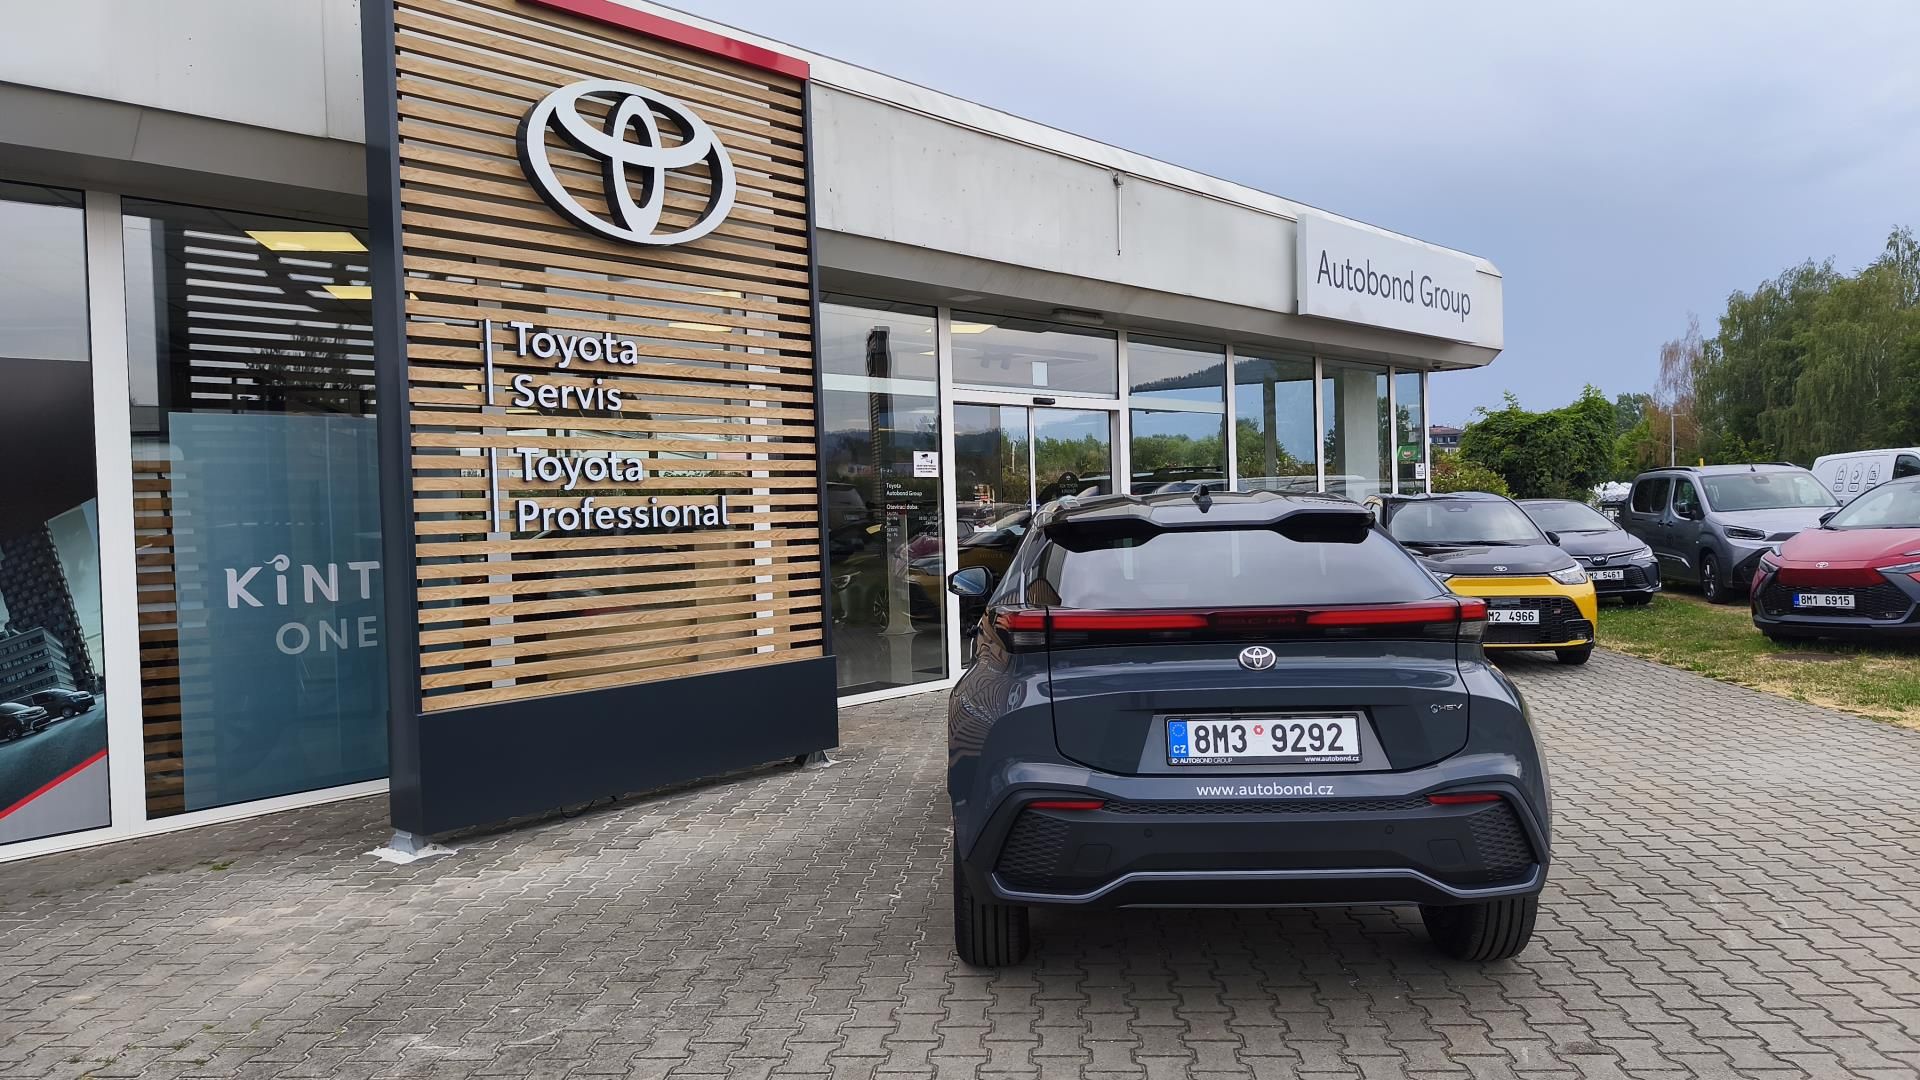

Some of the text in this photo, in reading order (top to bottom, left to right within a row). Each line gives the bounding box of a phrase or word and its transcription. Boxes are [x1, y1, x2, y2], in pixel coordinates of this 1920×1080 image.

[1317, 250, 1471, 322] Autobond Group
[511, 321, 638, 369] Toyota
[514, 374, 623, 411] Servis
[516, 447, 644, 490] Toyota
[517, 496, 730, 532] Professional
[1602, 571, 1621, 579] 5461
[1508, 611, 1535, 622] 4966
[1800, 595, 1818, 605] 8M1
[1825, 595, 1850, 606] 6915
[275, 616, 379, 655] ONE
[1173, 744, 1187, 755] CZ
[1194, 722, 1344, 754] 8M3 9292
[1304, 755, 1360, 763] www.autobond.cz
[1196, 782, 1335, 797] www.autobond.cz
